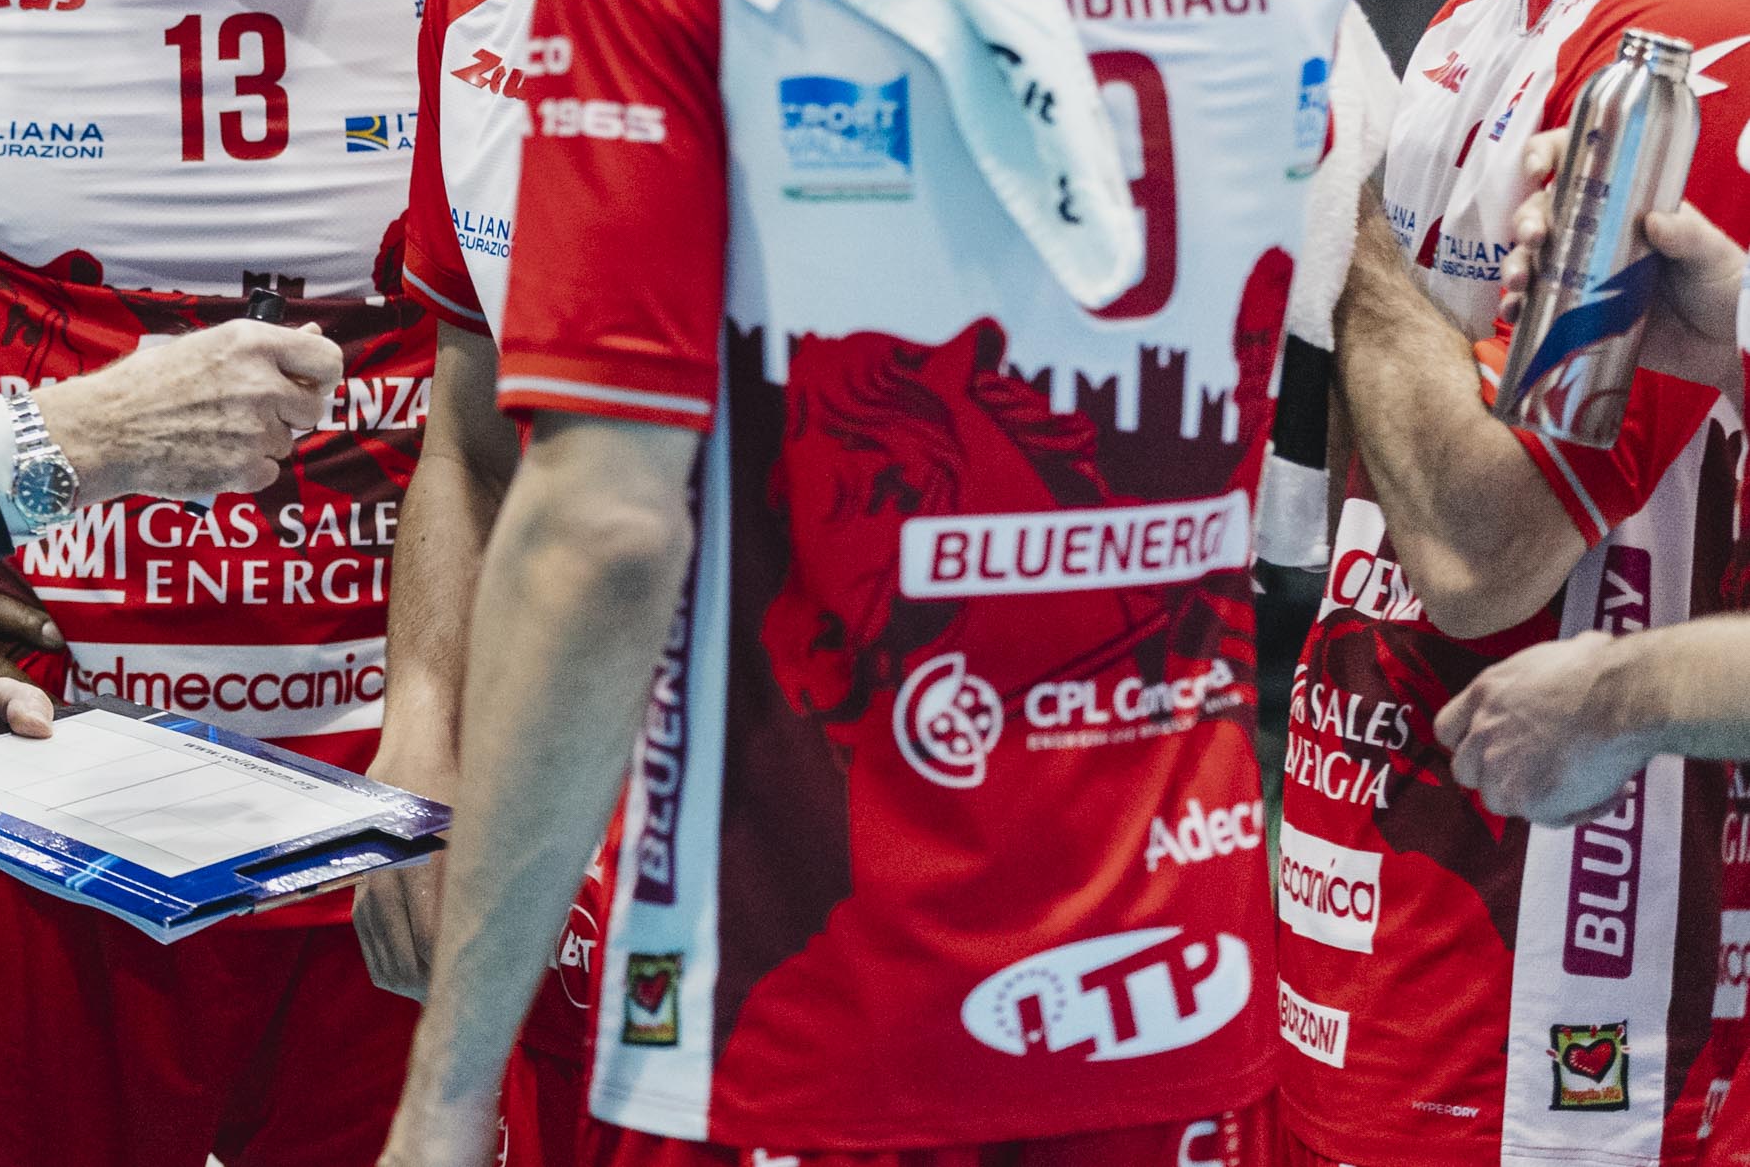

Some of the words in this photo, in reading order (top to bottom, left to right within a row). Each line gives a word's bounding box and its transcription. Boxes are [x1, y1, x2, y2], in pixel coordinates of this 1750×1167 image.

[165, 12, 289, 162] 13
[451, 207, 511, 241] ALIAN
[457, 233, 512, 258] CURAZIO
[312, 376, 433, 434] ENZA
[138, 501, 260, 550] GAS
[279, 501, 396, 549] SALE
[146, 557, 384, 606] ENERGI
[1024, 680, 1110, 728] CPL
[1311, 683, 1413, 751] SALES
[1145, 796, 1267, 873] Adec
